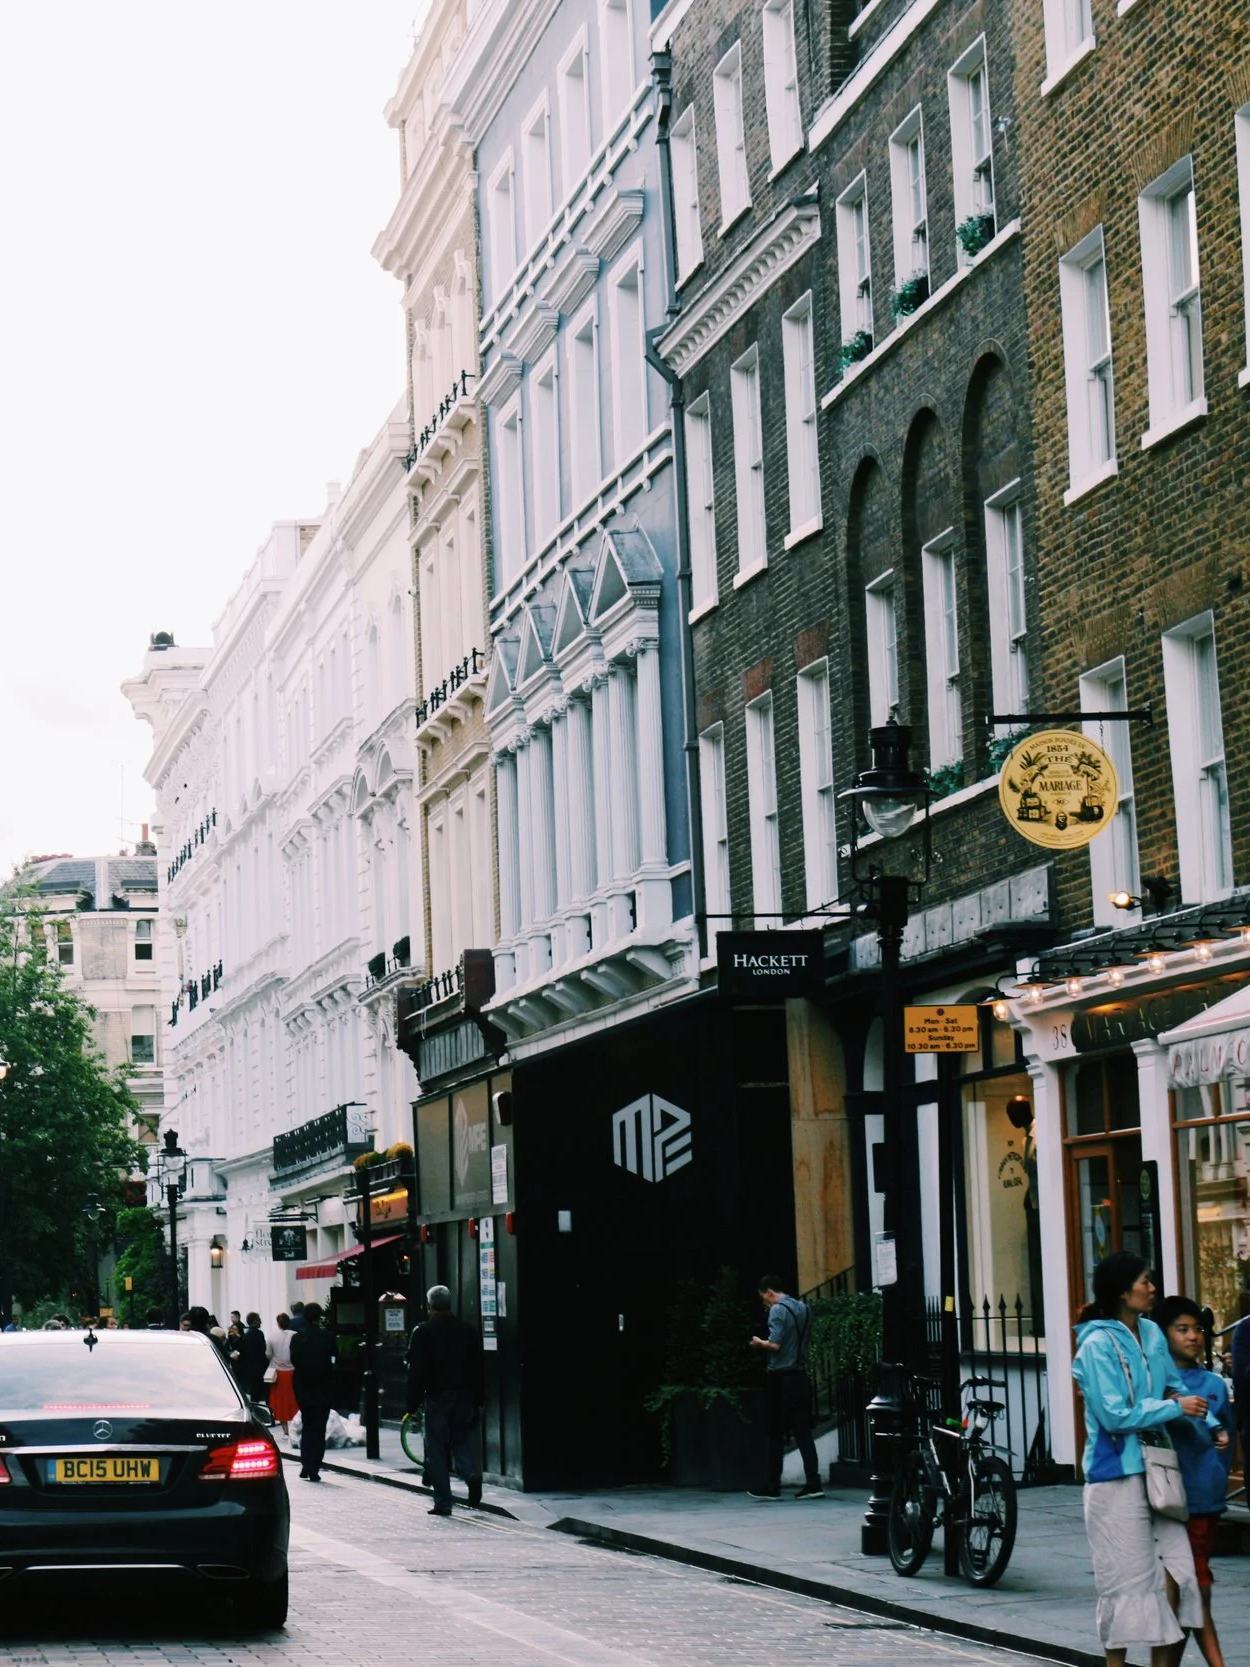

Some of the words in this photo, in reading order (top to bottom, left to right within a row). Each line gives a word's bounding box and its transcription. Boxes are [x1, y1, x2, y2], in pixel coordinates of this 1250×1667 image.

[1046, 744, 1069, 753] 1854
[1039, 780, 1083, 792] MARIAGE
[733, 953, 809, 968] HACKETT
[752, 968, 790, 976] LONDON
[1053, 1024, 1067, 1050] 38
[63, 1460, 107, 1478] BC15
[113, 1460, 151, 1478] UHW
